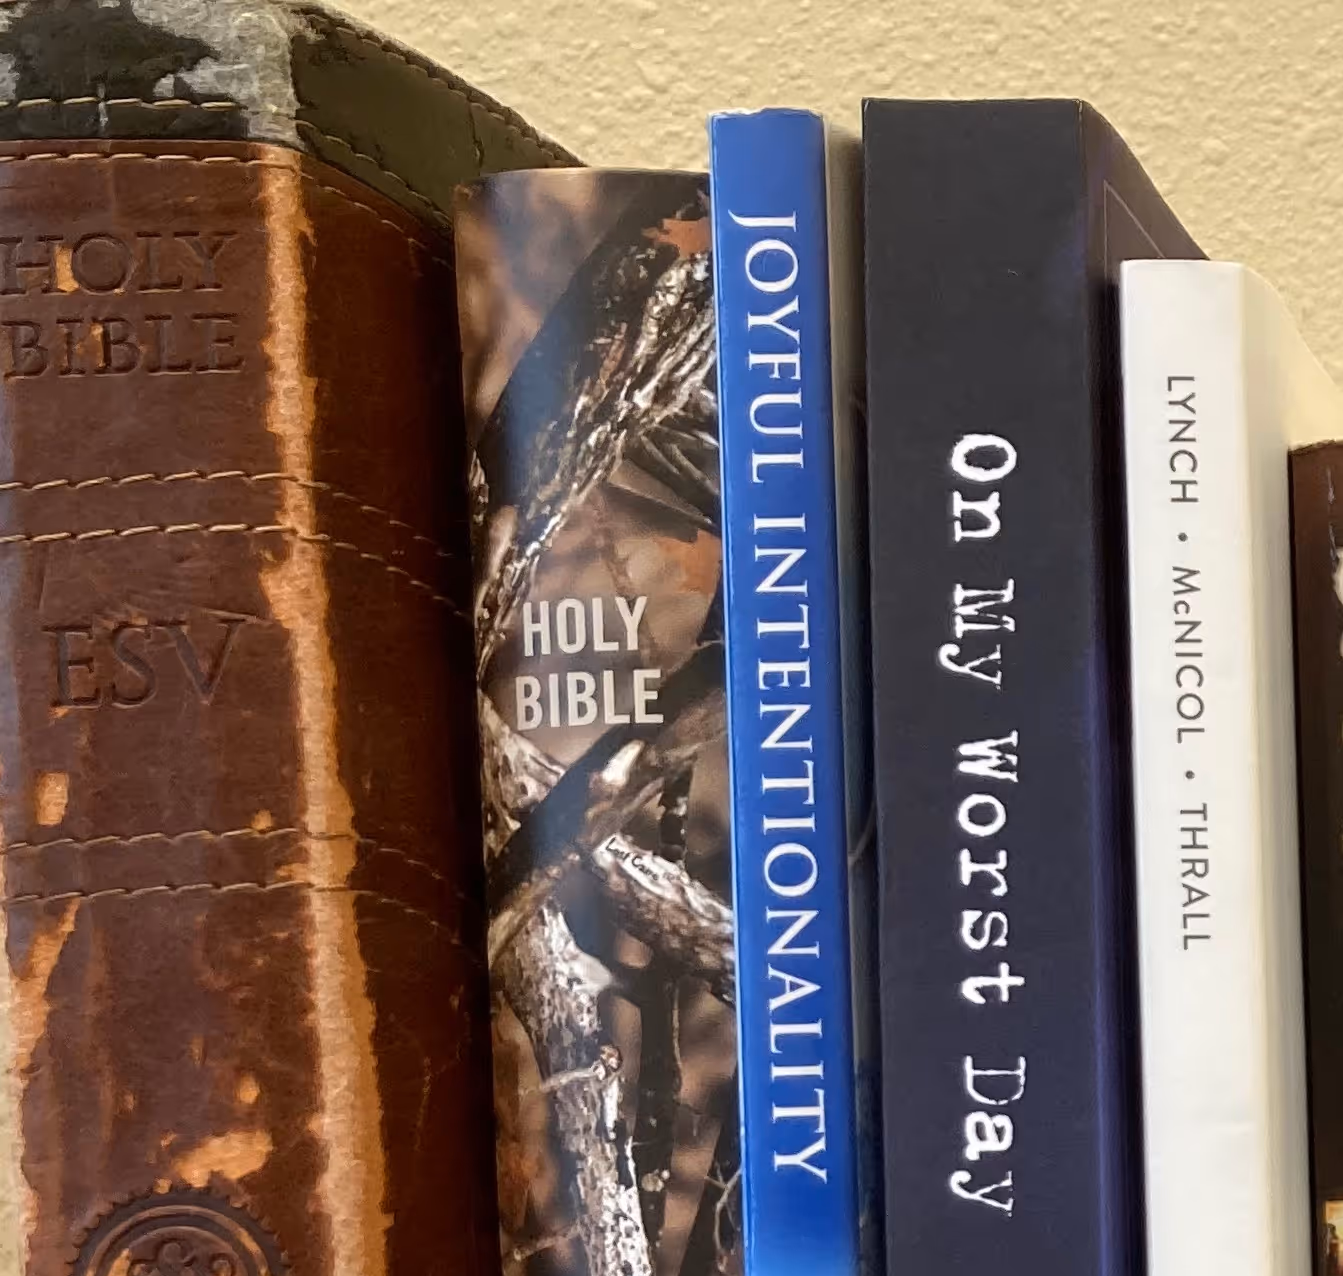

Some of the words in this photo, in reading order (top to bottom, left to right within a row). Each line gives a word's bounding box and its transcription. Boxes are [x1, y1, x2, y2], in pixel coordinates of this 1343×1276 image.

[1, 231, 238, 296] HOLY
[3, 314, 245, 378] BIBLE
[729, 210, 803, 482] JOYFUL
[950, 432, 1018, 542] On
[1167, 375, 1199, 504] LYNCH
[43, 619, 246, 709] ESV
[523, 596, 649, 658] HOLY
[938, 577, 1016, 691] My
[1172, 567, 1206, 745] McNICOL
[515, 668, 665, 730] BIBLE
[752, 514, 827, 1184] INTENTIONALITY
[956, 729, 1025, 1004] Worst
[1179, 804, 1211, 951] THRALL
[947, 1056, 1028, 1218] Day
